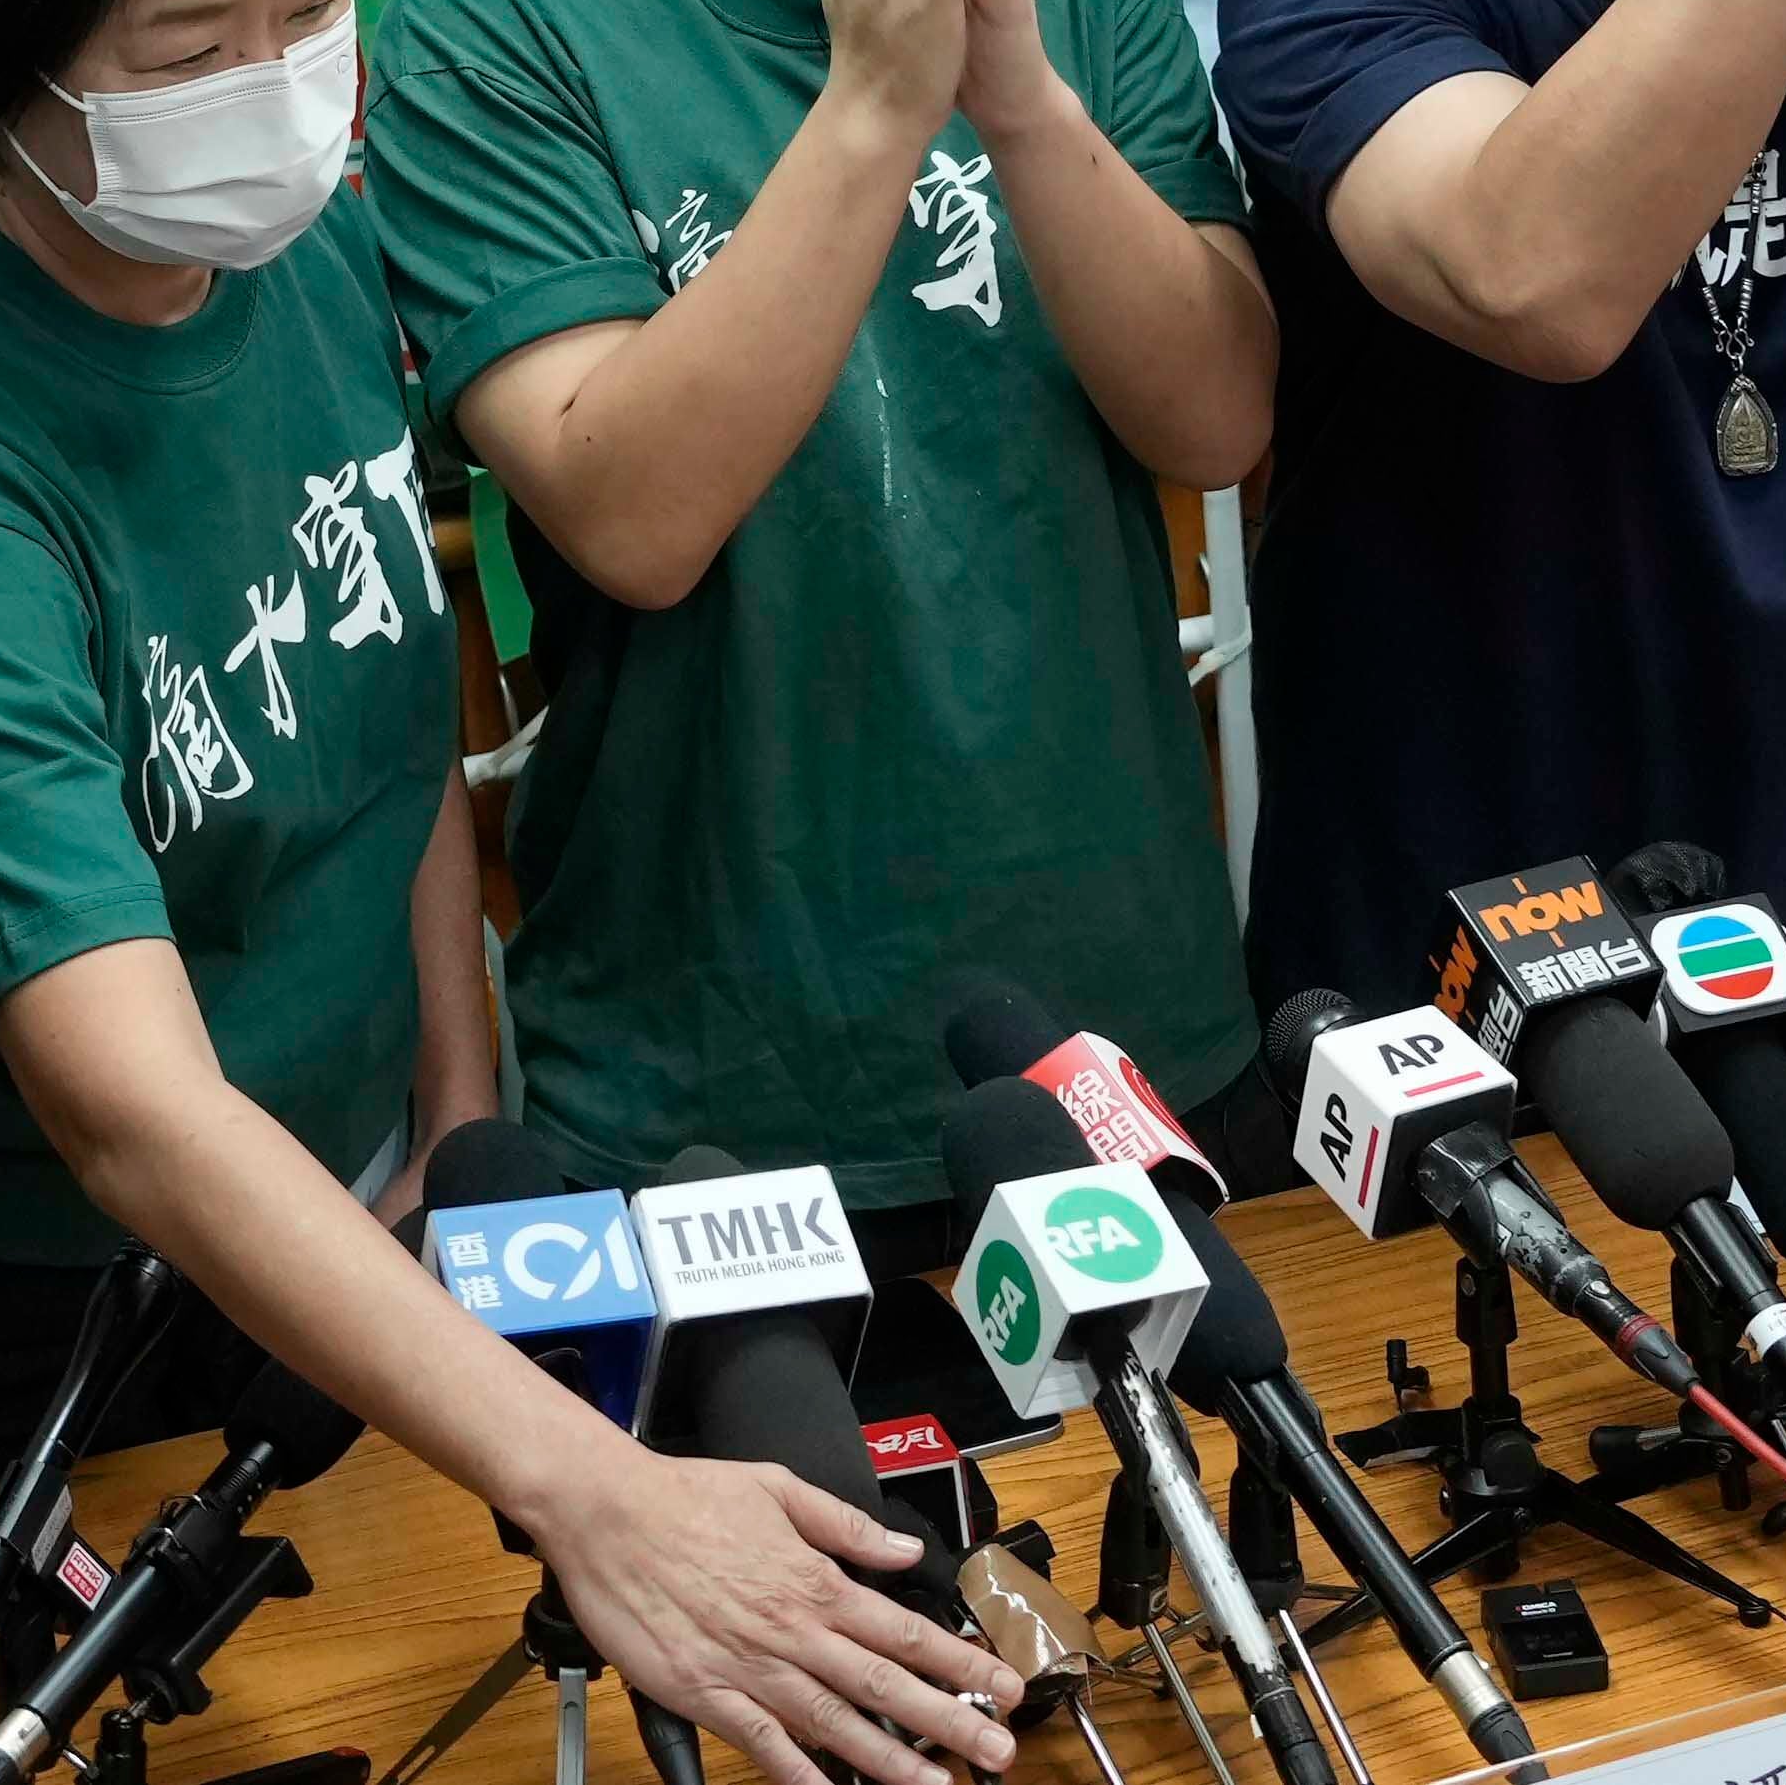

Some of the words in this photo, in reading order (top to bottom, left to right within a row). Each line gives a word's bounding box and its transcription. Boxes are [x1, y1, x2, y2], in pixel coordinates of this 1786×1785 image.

[1517, 938, 1651, 999] 新聞台
[1376, 1033, 1445, 1075] AP
[1319, 1092, 1354, 1183] AP
[658, 1197, 840, 1265] TMHK
[1045, 1215, 1141, 1261] RFA
[446, 1230, 504, 1312] 香港
[673, 1265, 720, 1286] TRUTH
[722, 1260, 766, 1281] MEDIA
[768, 1254, 806, 1272] HONG
[808, 1248, 846, 1267] KONG
[981, 1275, 1027, 1351] RFA
